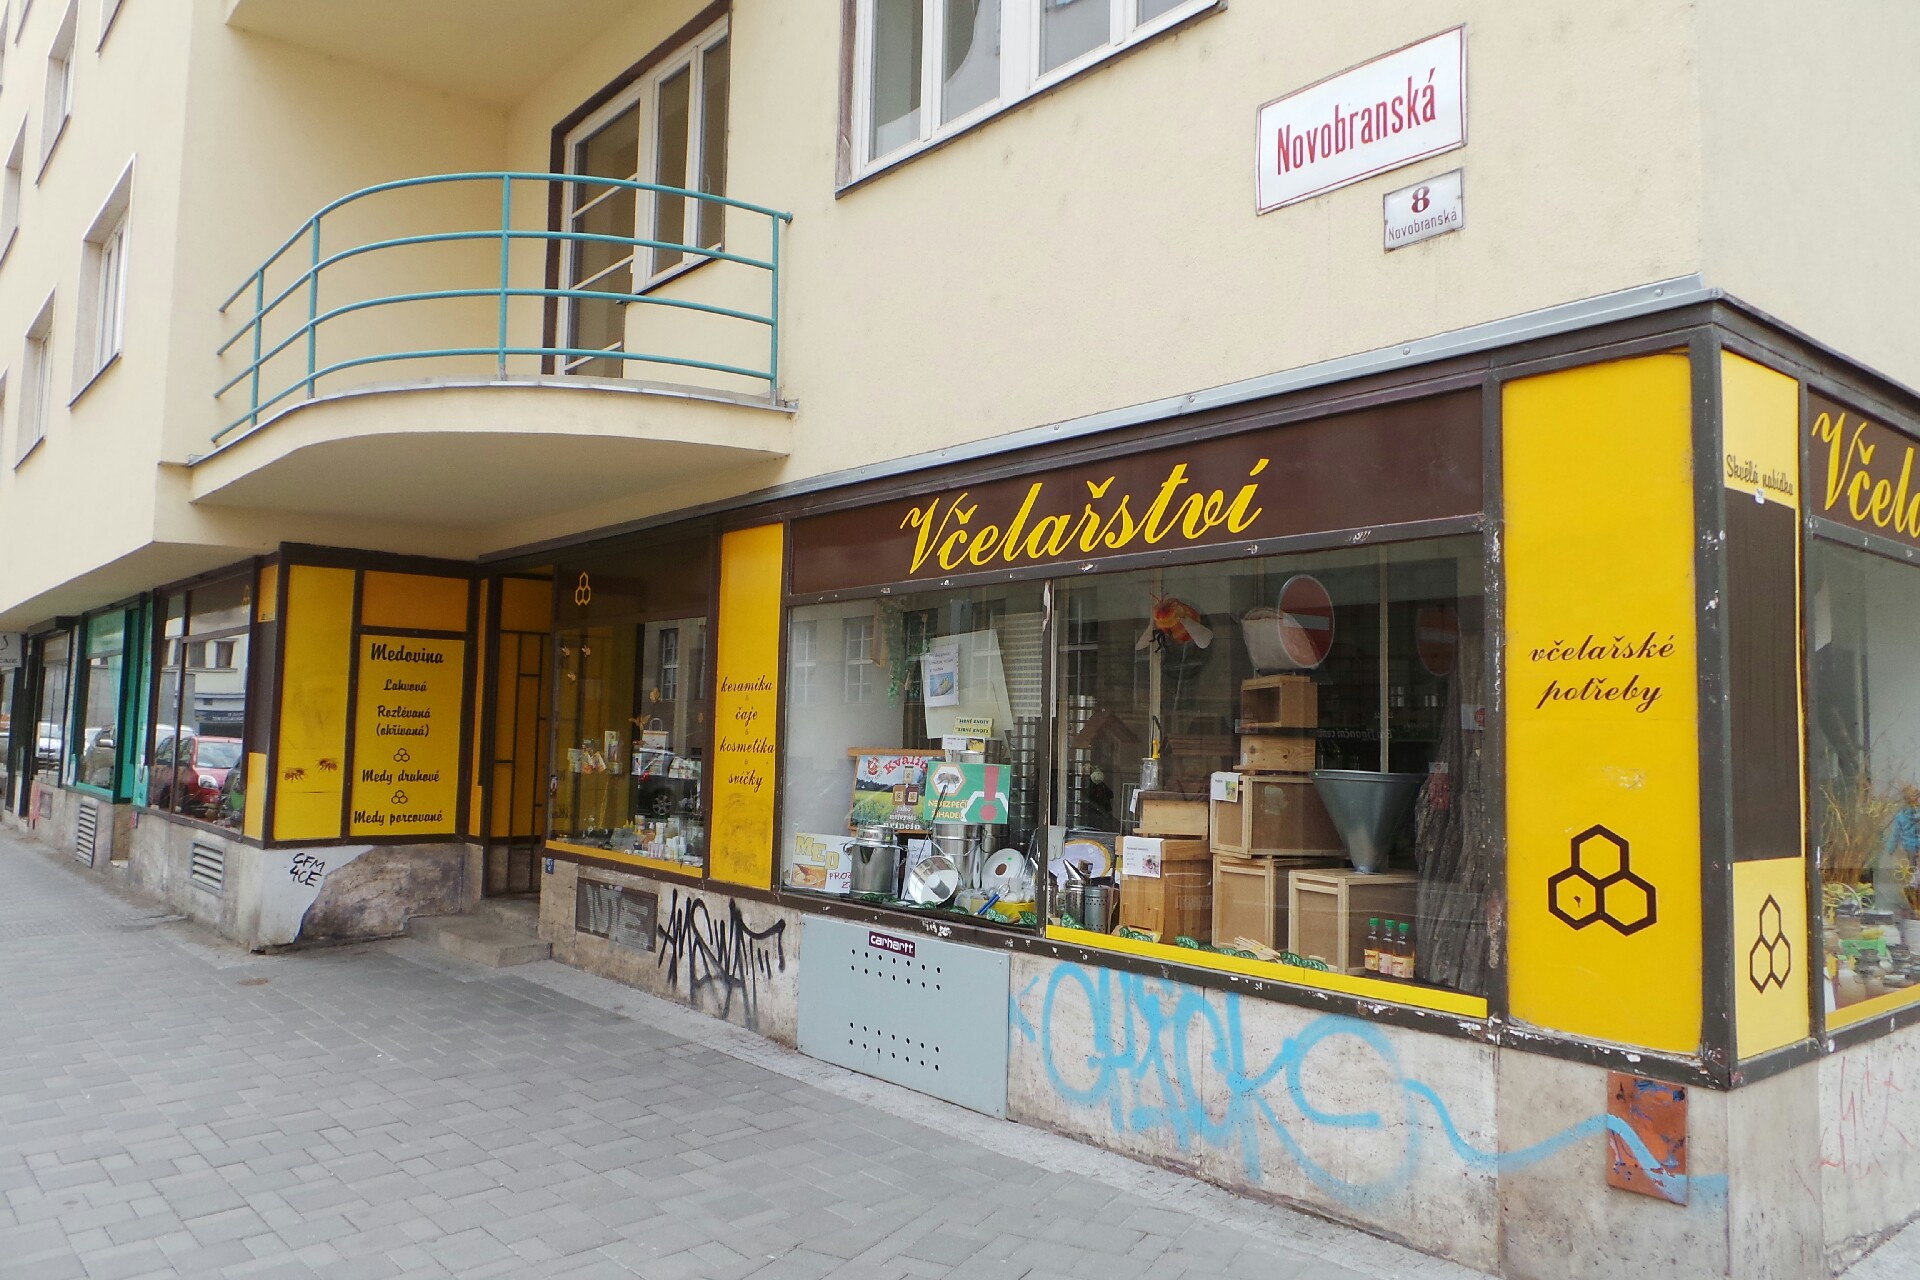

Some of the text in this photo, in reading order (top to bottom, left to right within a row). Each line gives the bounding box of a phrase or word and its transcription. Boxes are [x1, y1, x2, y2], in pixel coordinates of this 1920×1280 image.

[1277, 67, 1436, 176] Novobranská
[1411, 186, 1430, 213] 8
[1388, 206, 1457, 242] Novobranská
[1726, 454, 1794, 496] Skvělá nabídka
[900, 458, 1270, 575] Včelařství
[371, 643, 444, 664] Medovina
[1528, 631, 1675, 662] včelařské
[383, 679, 428, 692] Lahvová
[720, 675, 773, 692] keramika
[1536, 674, 1663, 713] potřeby
[377, 705, 431, 719] Rozlévaná
[735, 706, 758, 727] čaje
[719, 735, 776, 753] kosmetika
[362, 769, 440, 786] Medy druhové
[728, 769, 763, 793] svíčky
[353, 810, 443, 826] Medy porcované
[795, 835, 840, 870] MED
[870, 934, 914, 954] carhartt
